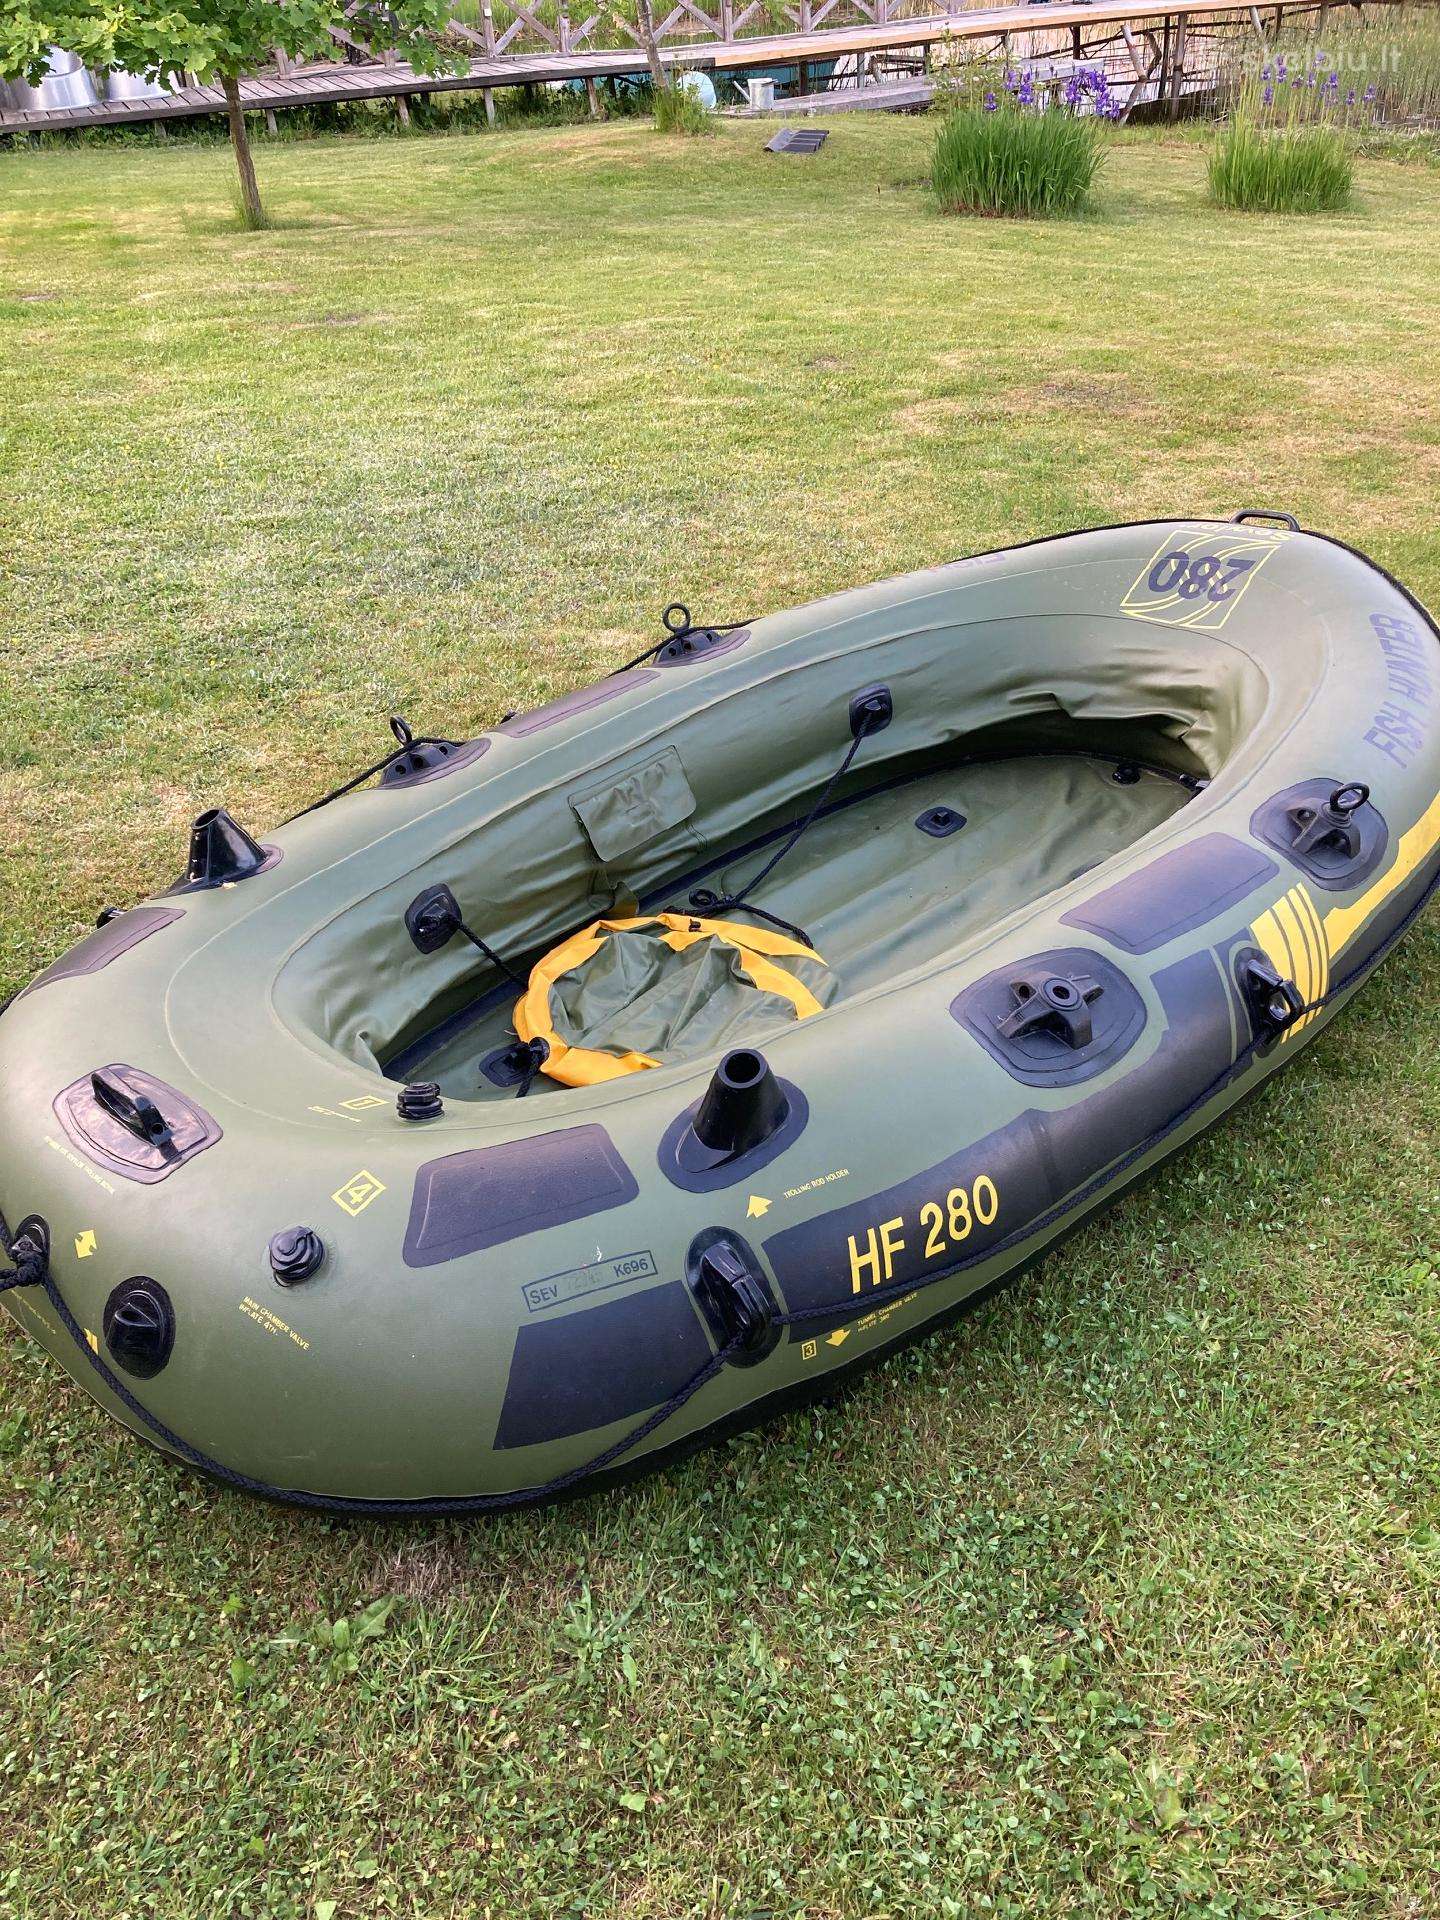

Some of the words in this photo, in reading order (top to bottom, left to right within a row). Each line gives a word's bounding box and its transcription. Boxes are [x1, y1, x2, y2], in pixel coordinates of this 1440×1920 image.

[1148, 551, 1257, 602] 280
[1369, 613, 1433, 707] HUNTER
[1363, 701, 1430, 769] FISH
[347, 1183, 373, 1204] 4
[784, 1183, 811, 1198] TROLLING
[811, 1178, 825, 1188] ROD
[825, 1168, 850, 1182] HOLDER
[847, 1216, 906, 1294] HF
[920, 1174, 999, 1259] 280
[529, 1284, 559, 1304] SEV
[613, 1258, 649, 1277] K696
[239, 1303, 264, 1324] INFLATE
[243, 1296, 260, 1311] MAIN
[260, 1308, 290, 1332] CHAMBER
[289, 1330, 310, 1350] VALVE
